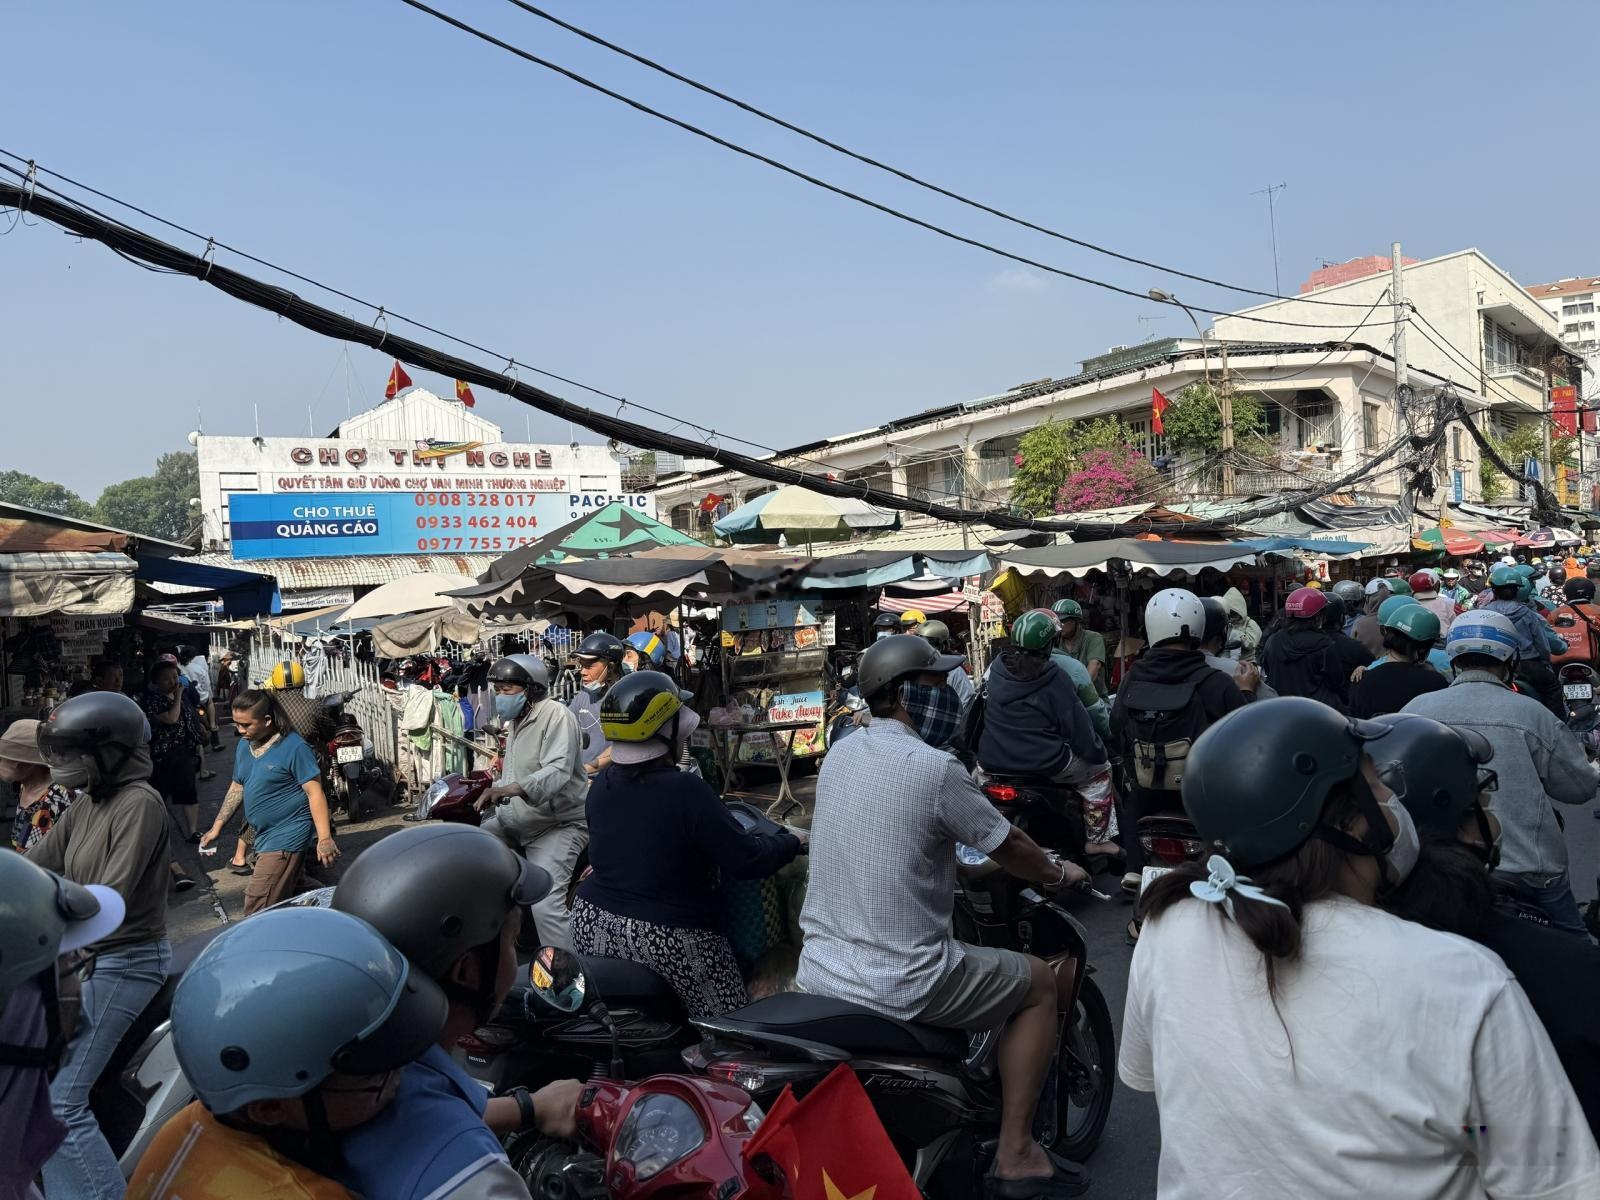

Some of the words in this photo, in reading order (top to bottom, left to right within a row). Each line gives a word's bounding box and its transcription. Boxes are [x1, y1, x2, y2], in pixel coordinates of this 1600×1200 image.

[290, 447, 367, 470] CHỢ
[465, 448, 552, 468] NGHÈ
[415, 493, 461, 506] 0908
[467, 494, 500, 506] 328
[504, 494, 536, 507] 017
[293, 506, 329, 518] CHO
[332, 503, 376, 517] THUÊ
[276, 520, 339, 537] QUẢNG
[342, 519, 377, 535] CÁO
[416, 516, 462, 529] 0933
[468, 516, 501, 528] 462
[506, 516, 538, 528] 404
[417, 537, 463, 551] 0977
[469, 537, 502, 550] 755
[769, 707, 793, 720] Take
